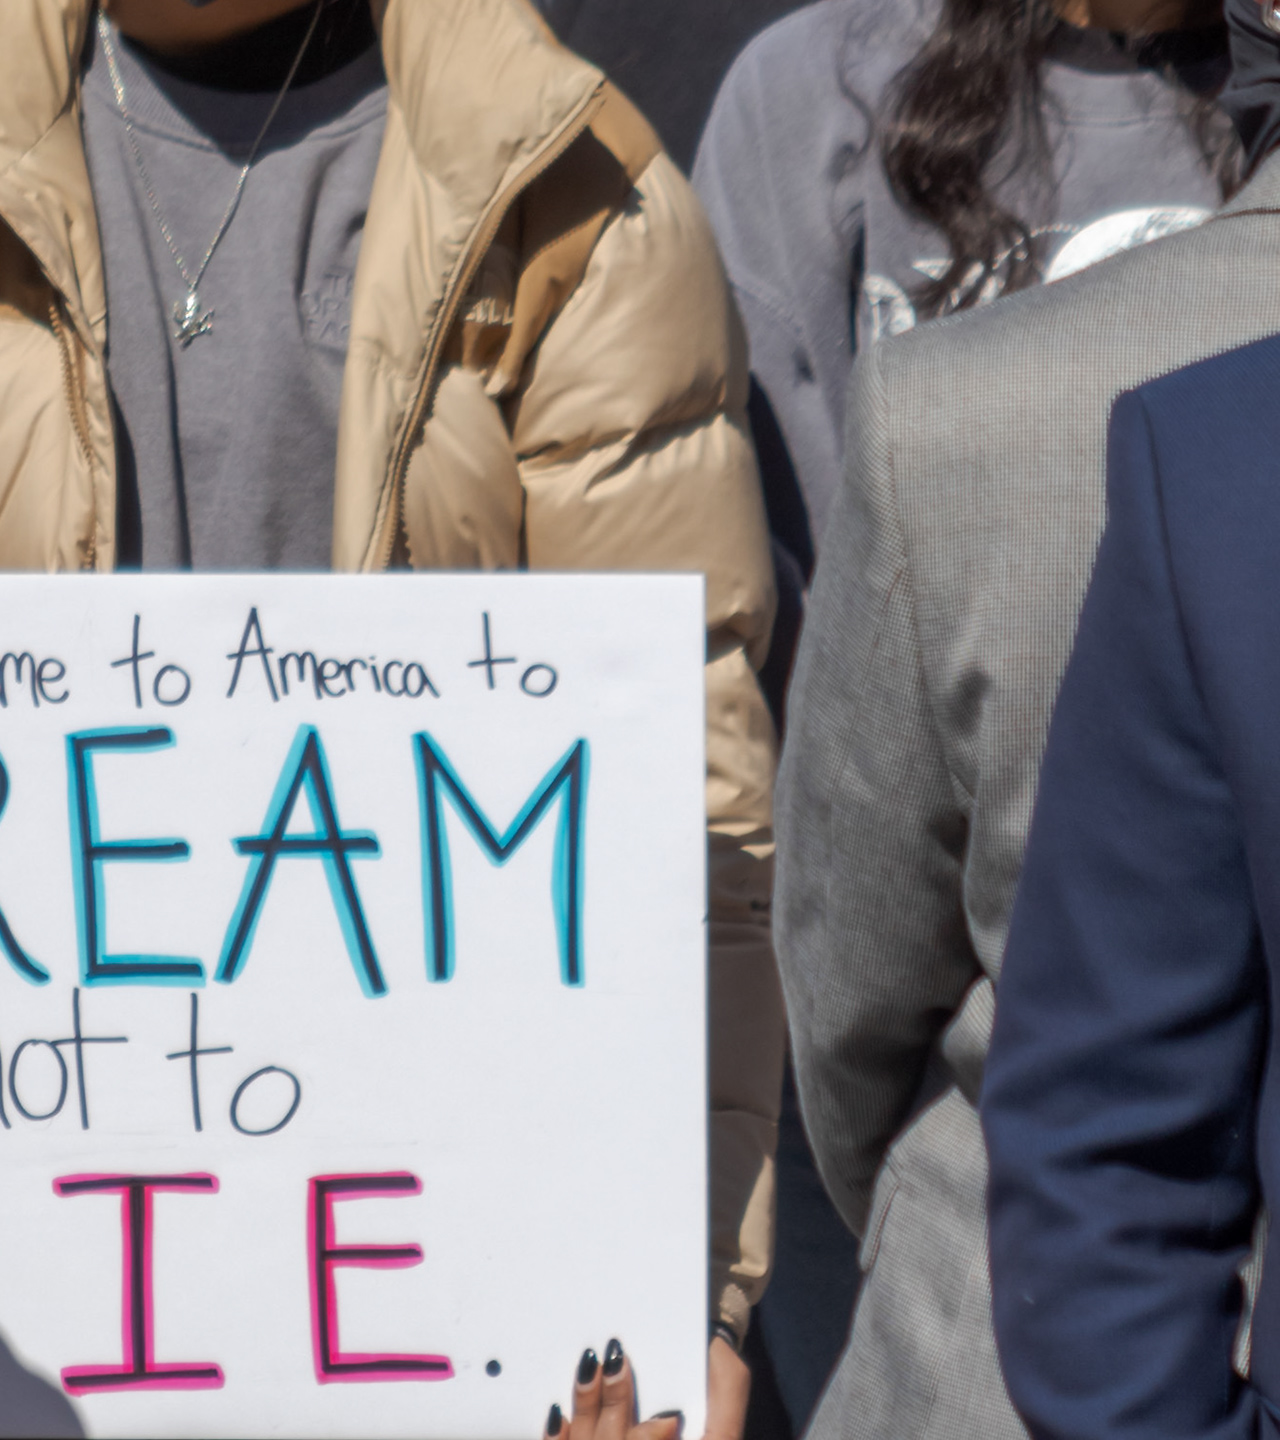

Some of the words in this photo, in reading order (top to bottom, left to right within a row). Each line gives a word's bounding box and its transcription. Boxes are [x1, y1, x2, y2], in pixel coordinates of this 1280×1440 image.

[111, 613, 192, 708] to
[226, 605, 439, 702] America
[468, 611, 557, 698] to
[166, 993, 303, 1137] to
